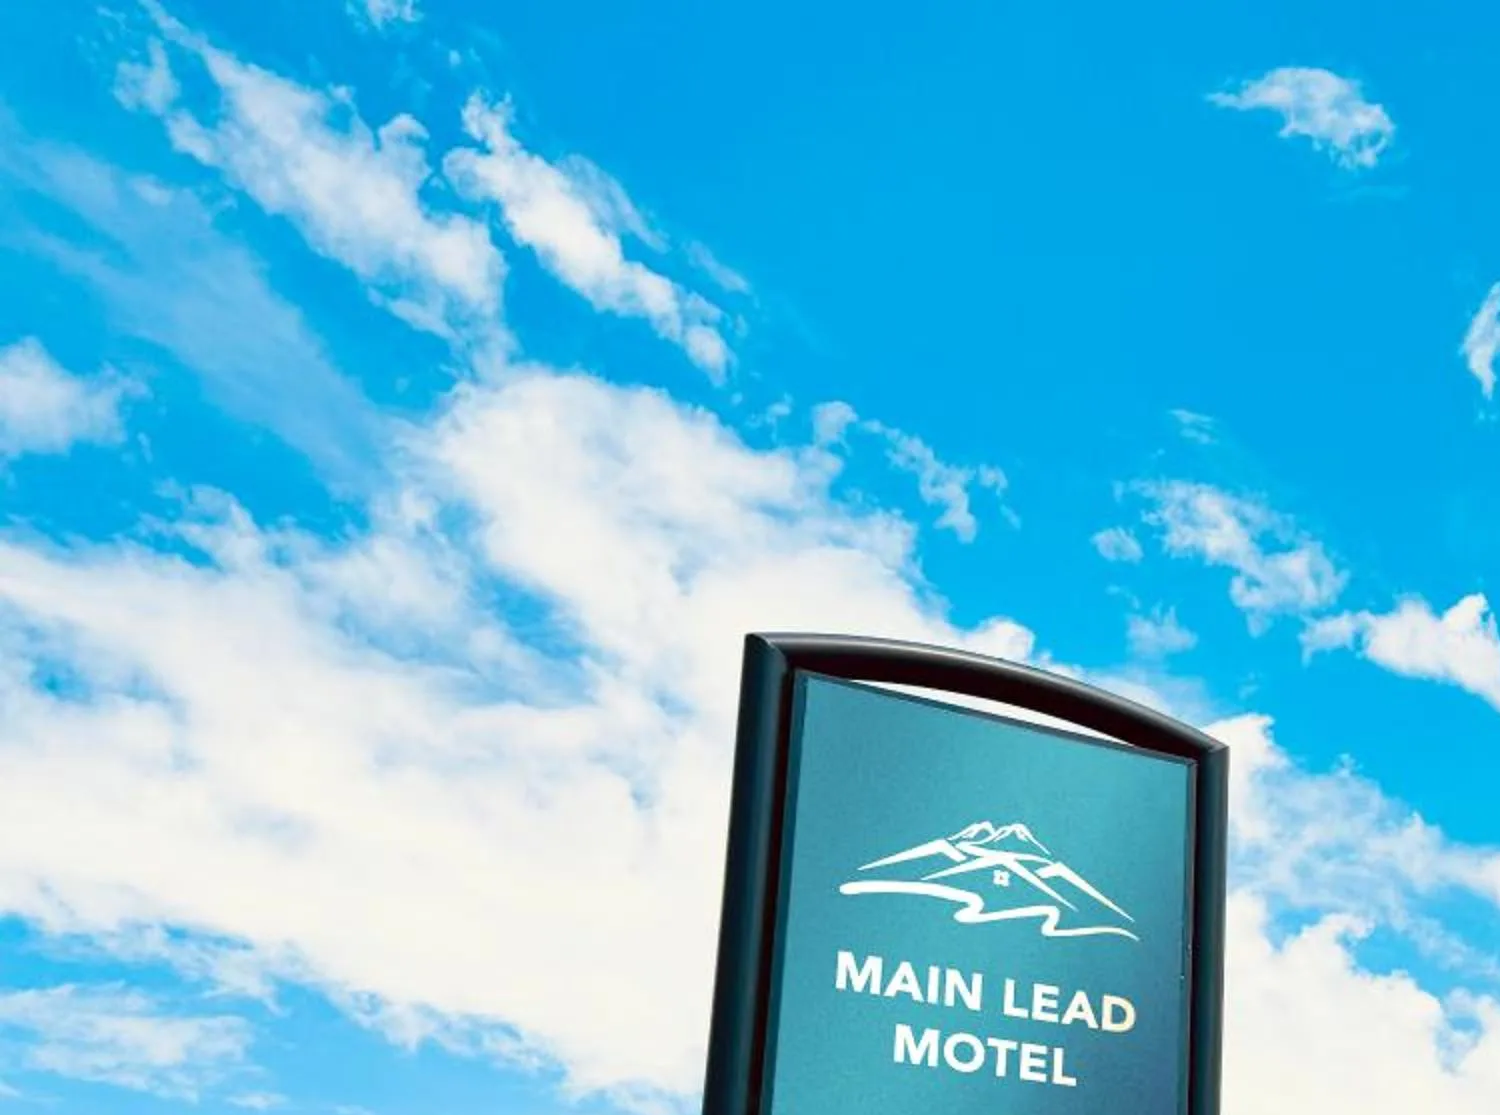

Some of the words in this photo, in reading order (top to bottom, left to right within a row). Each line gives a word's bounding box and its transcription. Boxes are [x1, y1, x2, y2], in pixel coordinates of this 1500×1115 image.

[835, 950, 983, 1011] MAIN
[1003, 978, 1137, 1033] LEAD
[893, 1023, 1077, 1087] MOTEL
